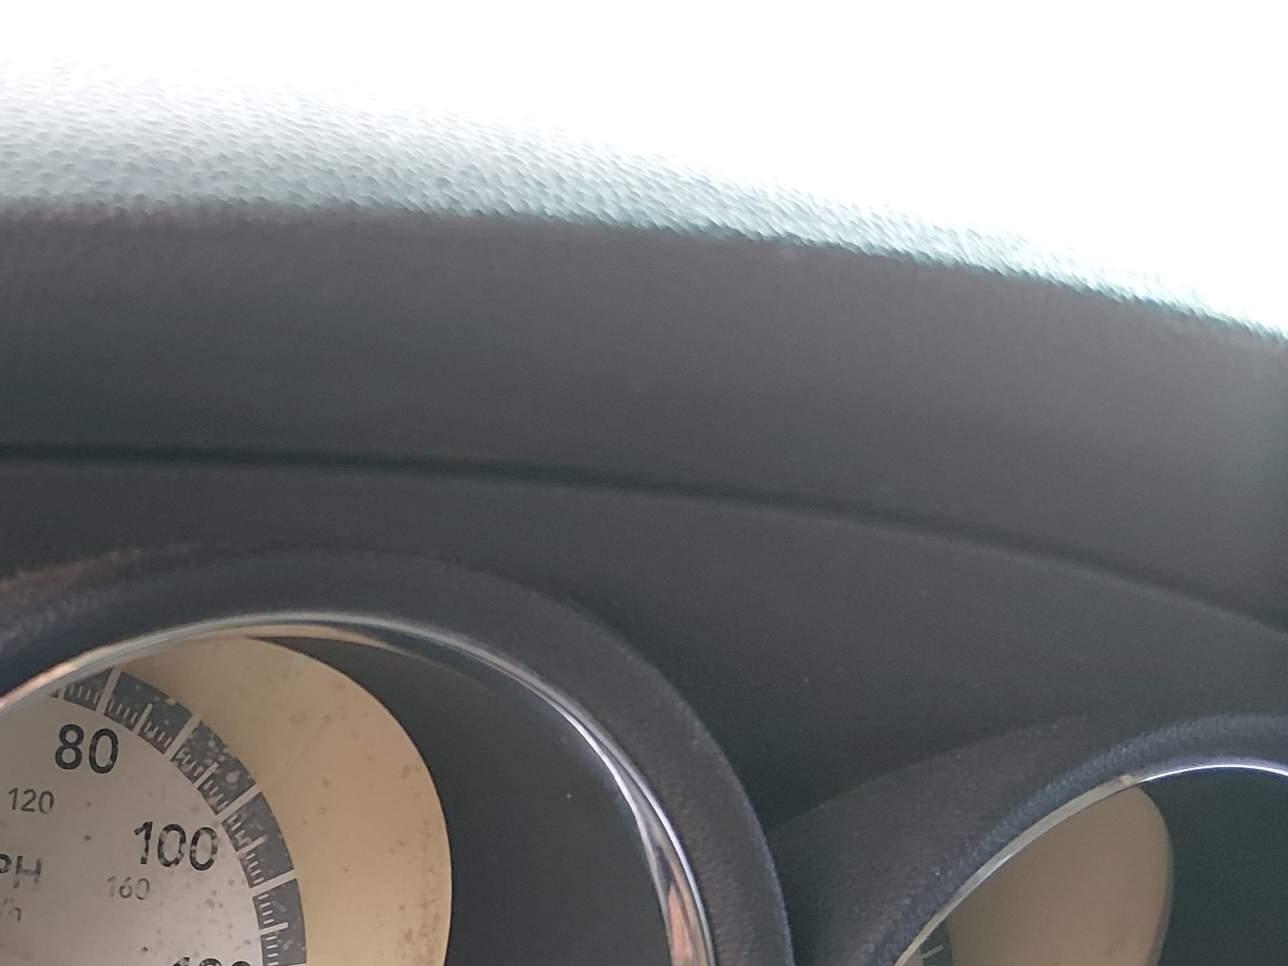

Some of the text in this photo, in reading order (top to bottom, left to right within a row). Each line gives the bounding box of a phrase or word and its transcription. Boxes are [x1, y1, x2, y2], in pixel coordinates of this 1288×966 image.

[54, 724, 120, 774] 80
[8, 787, 55, 815] 120
[134, 821, 218, 871] 100
[107, 876, 150, 901] 160
